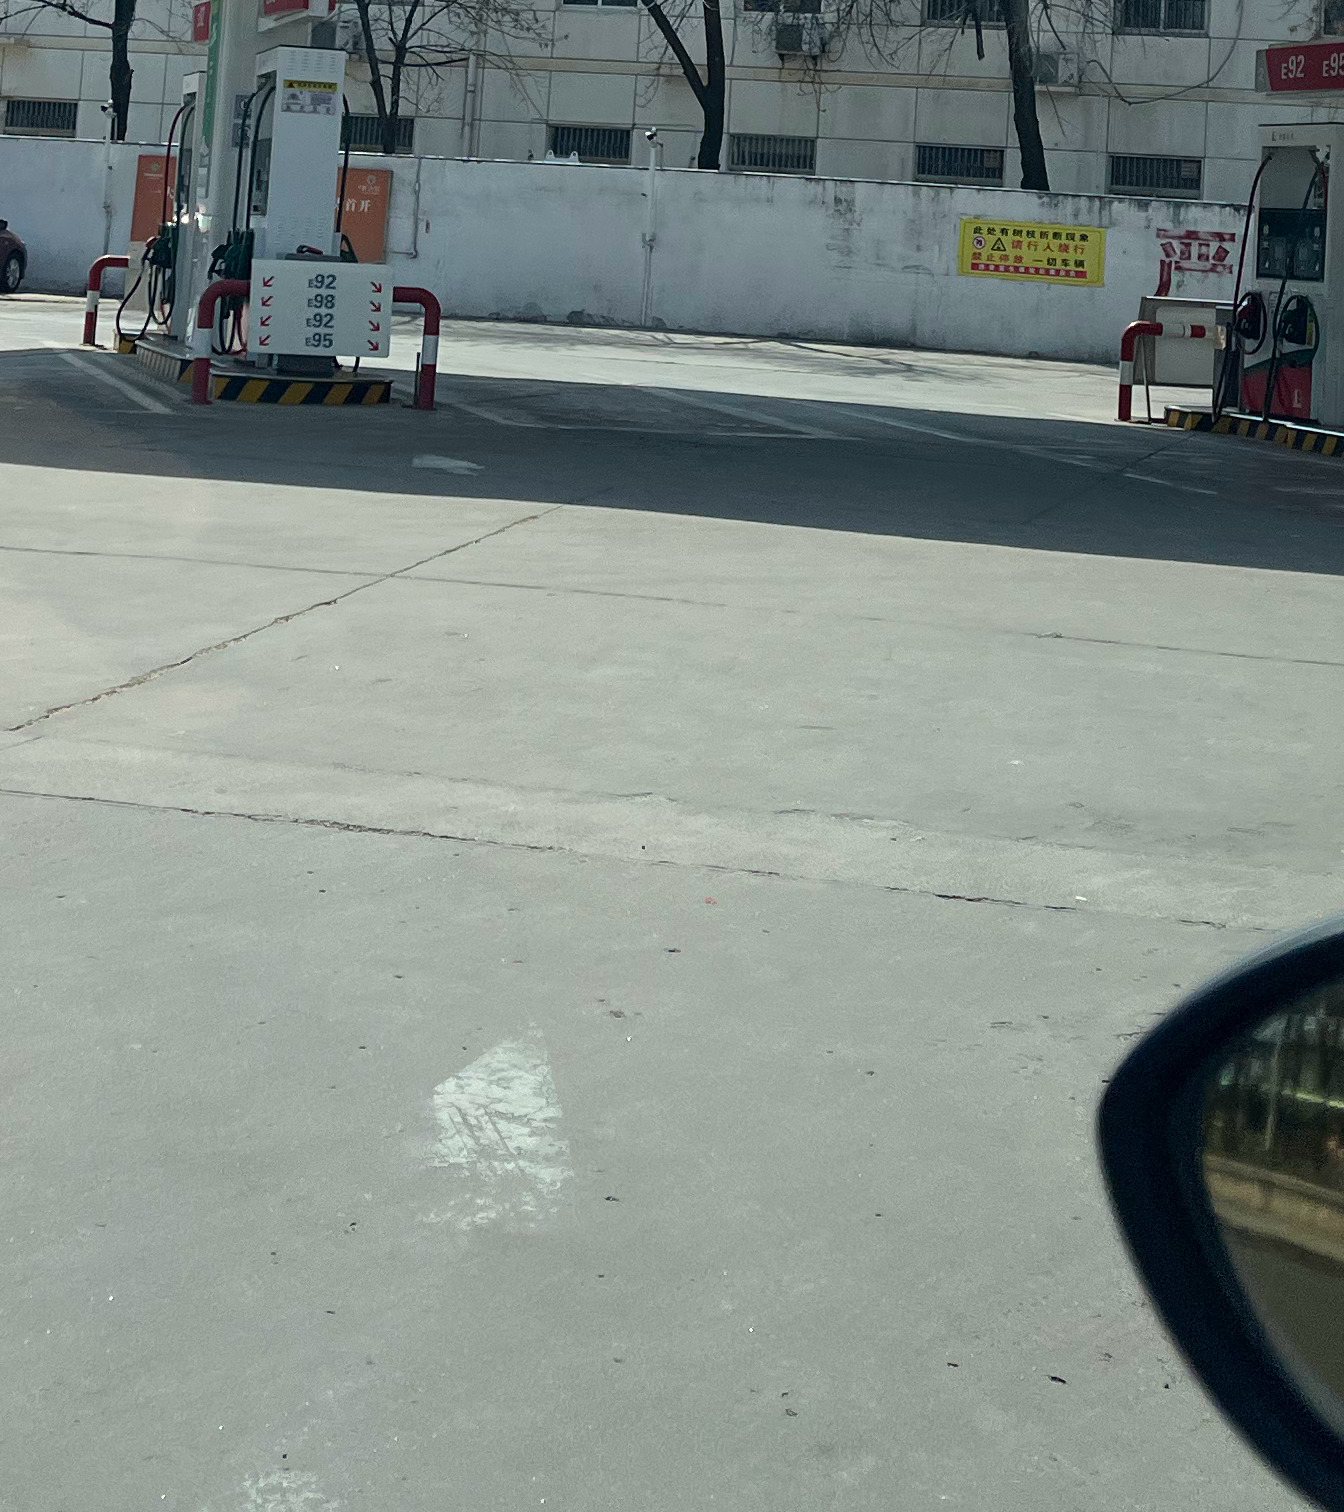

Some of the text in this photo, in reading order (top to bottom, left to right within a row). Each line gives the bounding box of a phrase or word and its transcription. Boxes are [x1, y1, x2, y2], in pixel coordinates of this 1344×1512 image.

[1281, 55, 1305, 80] E92
[307, 274, 337, 289] E92
[307, 294, 336, 309] E98
[306, 313, 334, 328] E92
[305, 333, 333, 348] E95
